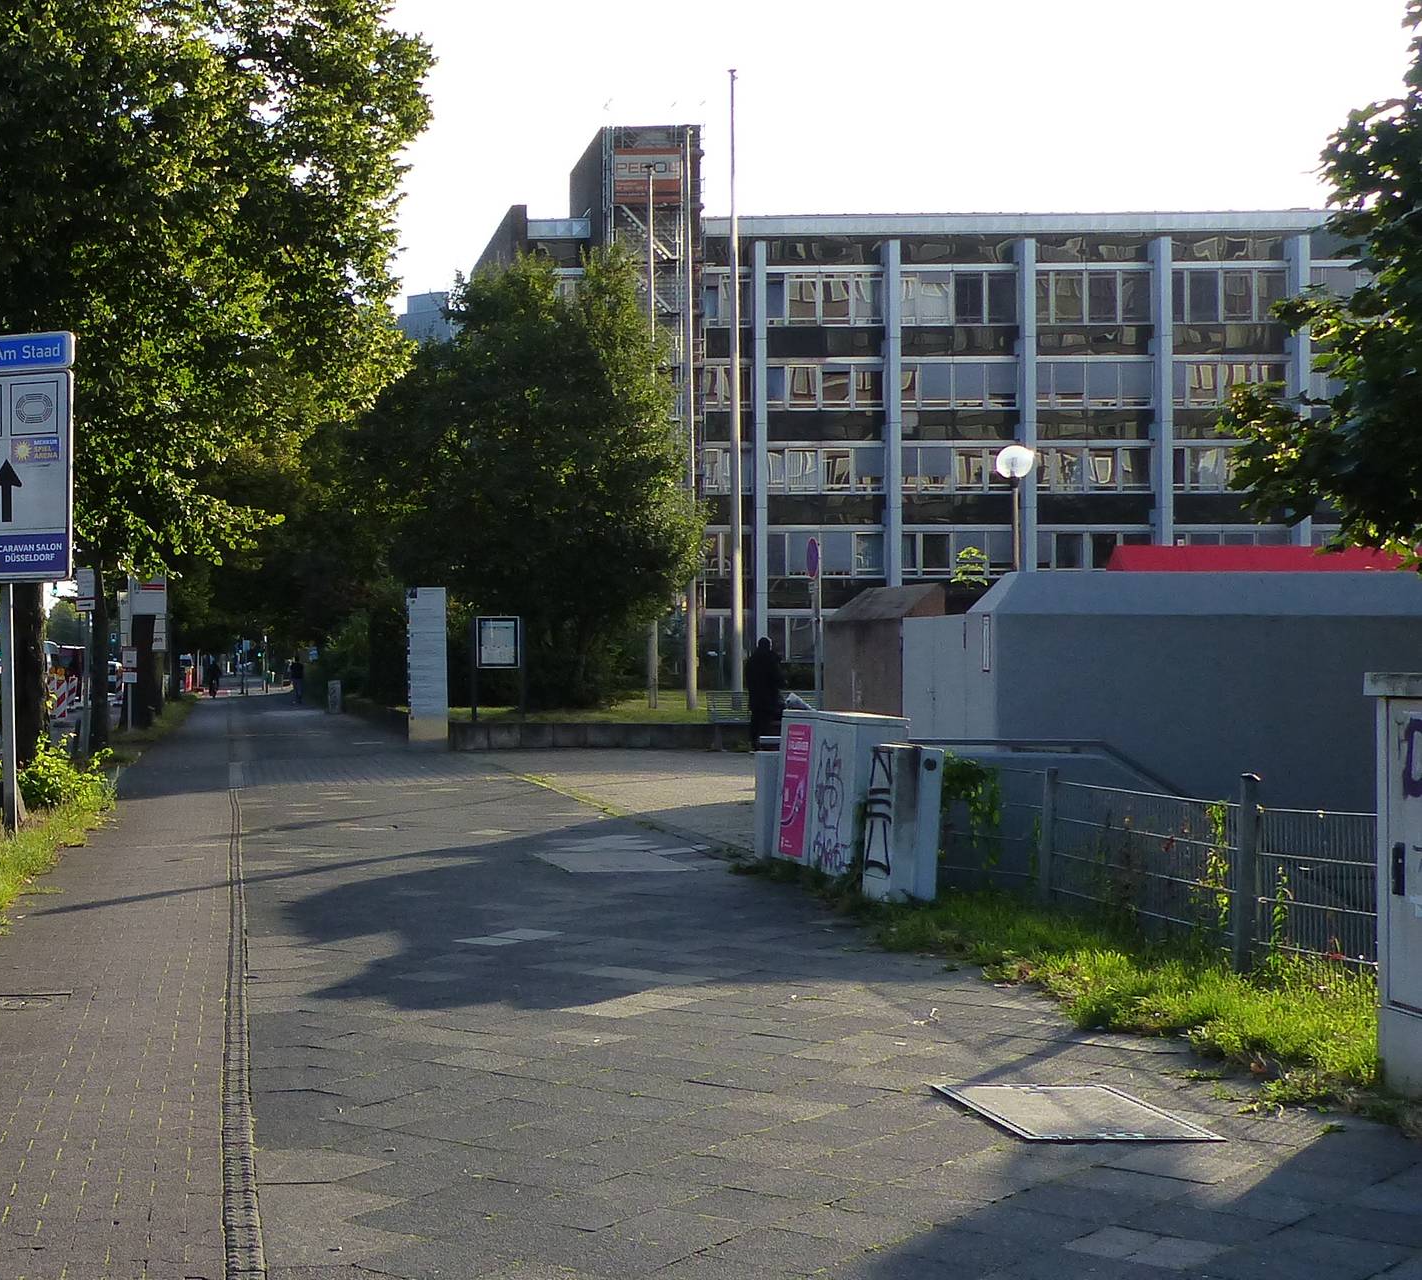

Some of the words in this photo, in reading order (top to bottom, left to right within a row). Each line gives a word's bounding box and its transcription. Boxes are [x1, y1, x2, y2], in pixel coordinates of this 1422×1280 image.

[22, 343, 61, 359] Staad
[35, 542, 63, 552] SALON
[4, 552, 56, 563] DÜSSELDORF
